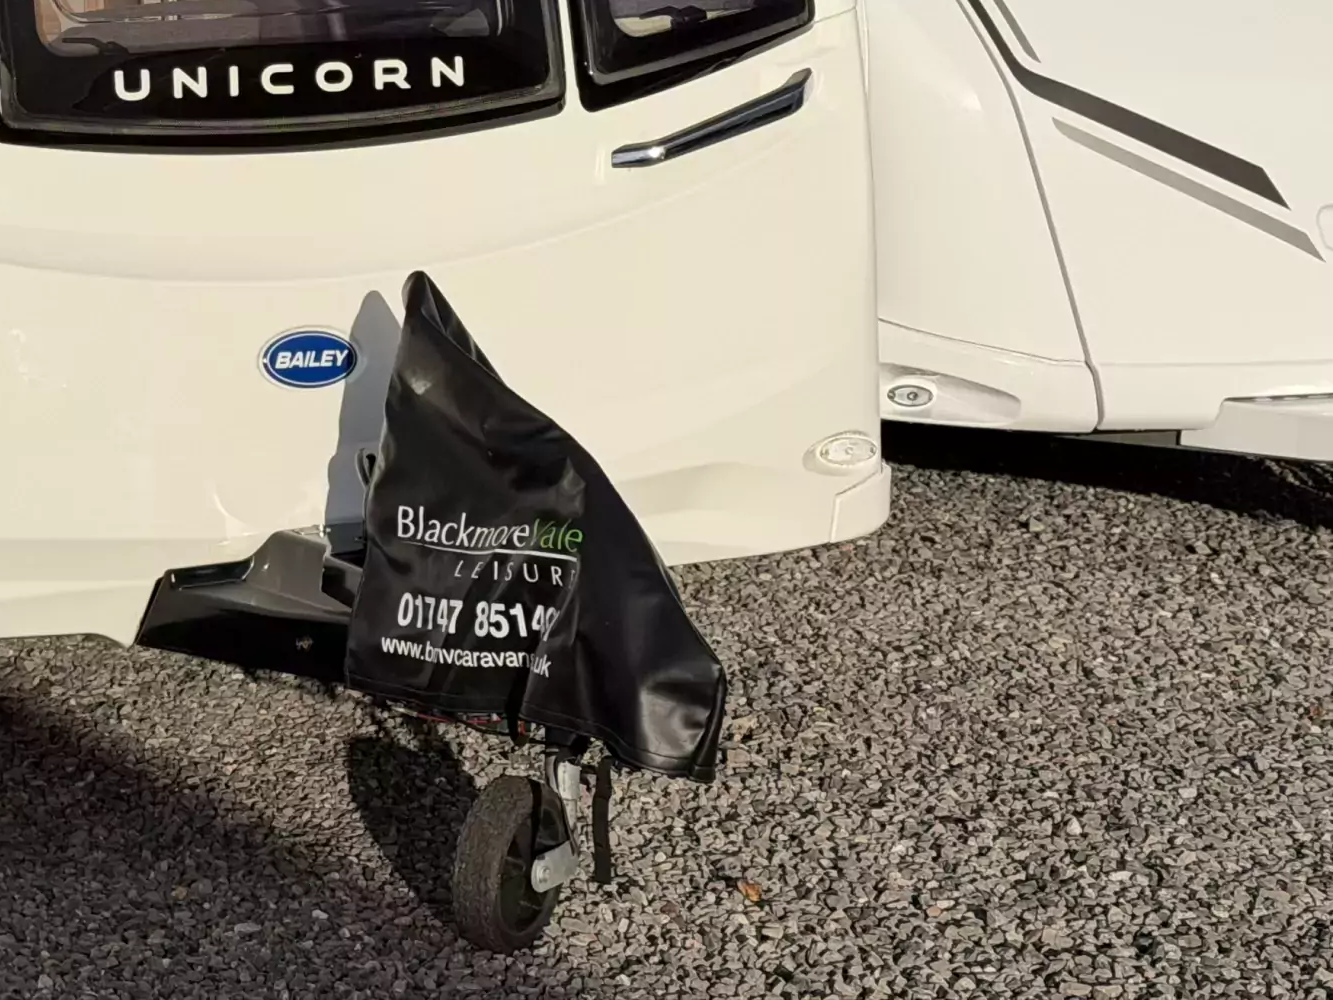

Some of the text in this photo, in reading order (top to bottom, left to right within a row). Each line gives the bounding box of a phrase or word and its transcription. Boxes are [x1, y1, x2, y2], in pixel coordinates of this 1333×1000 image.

[113, 55, 466, 102] UNICORN
[274, 349, 349, 370] BAILEY
[397, 592, 464, 634] 01747
